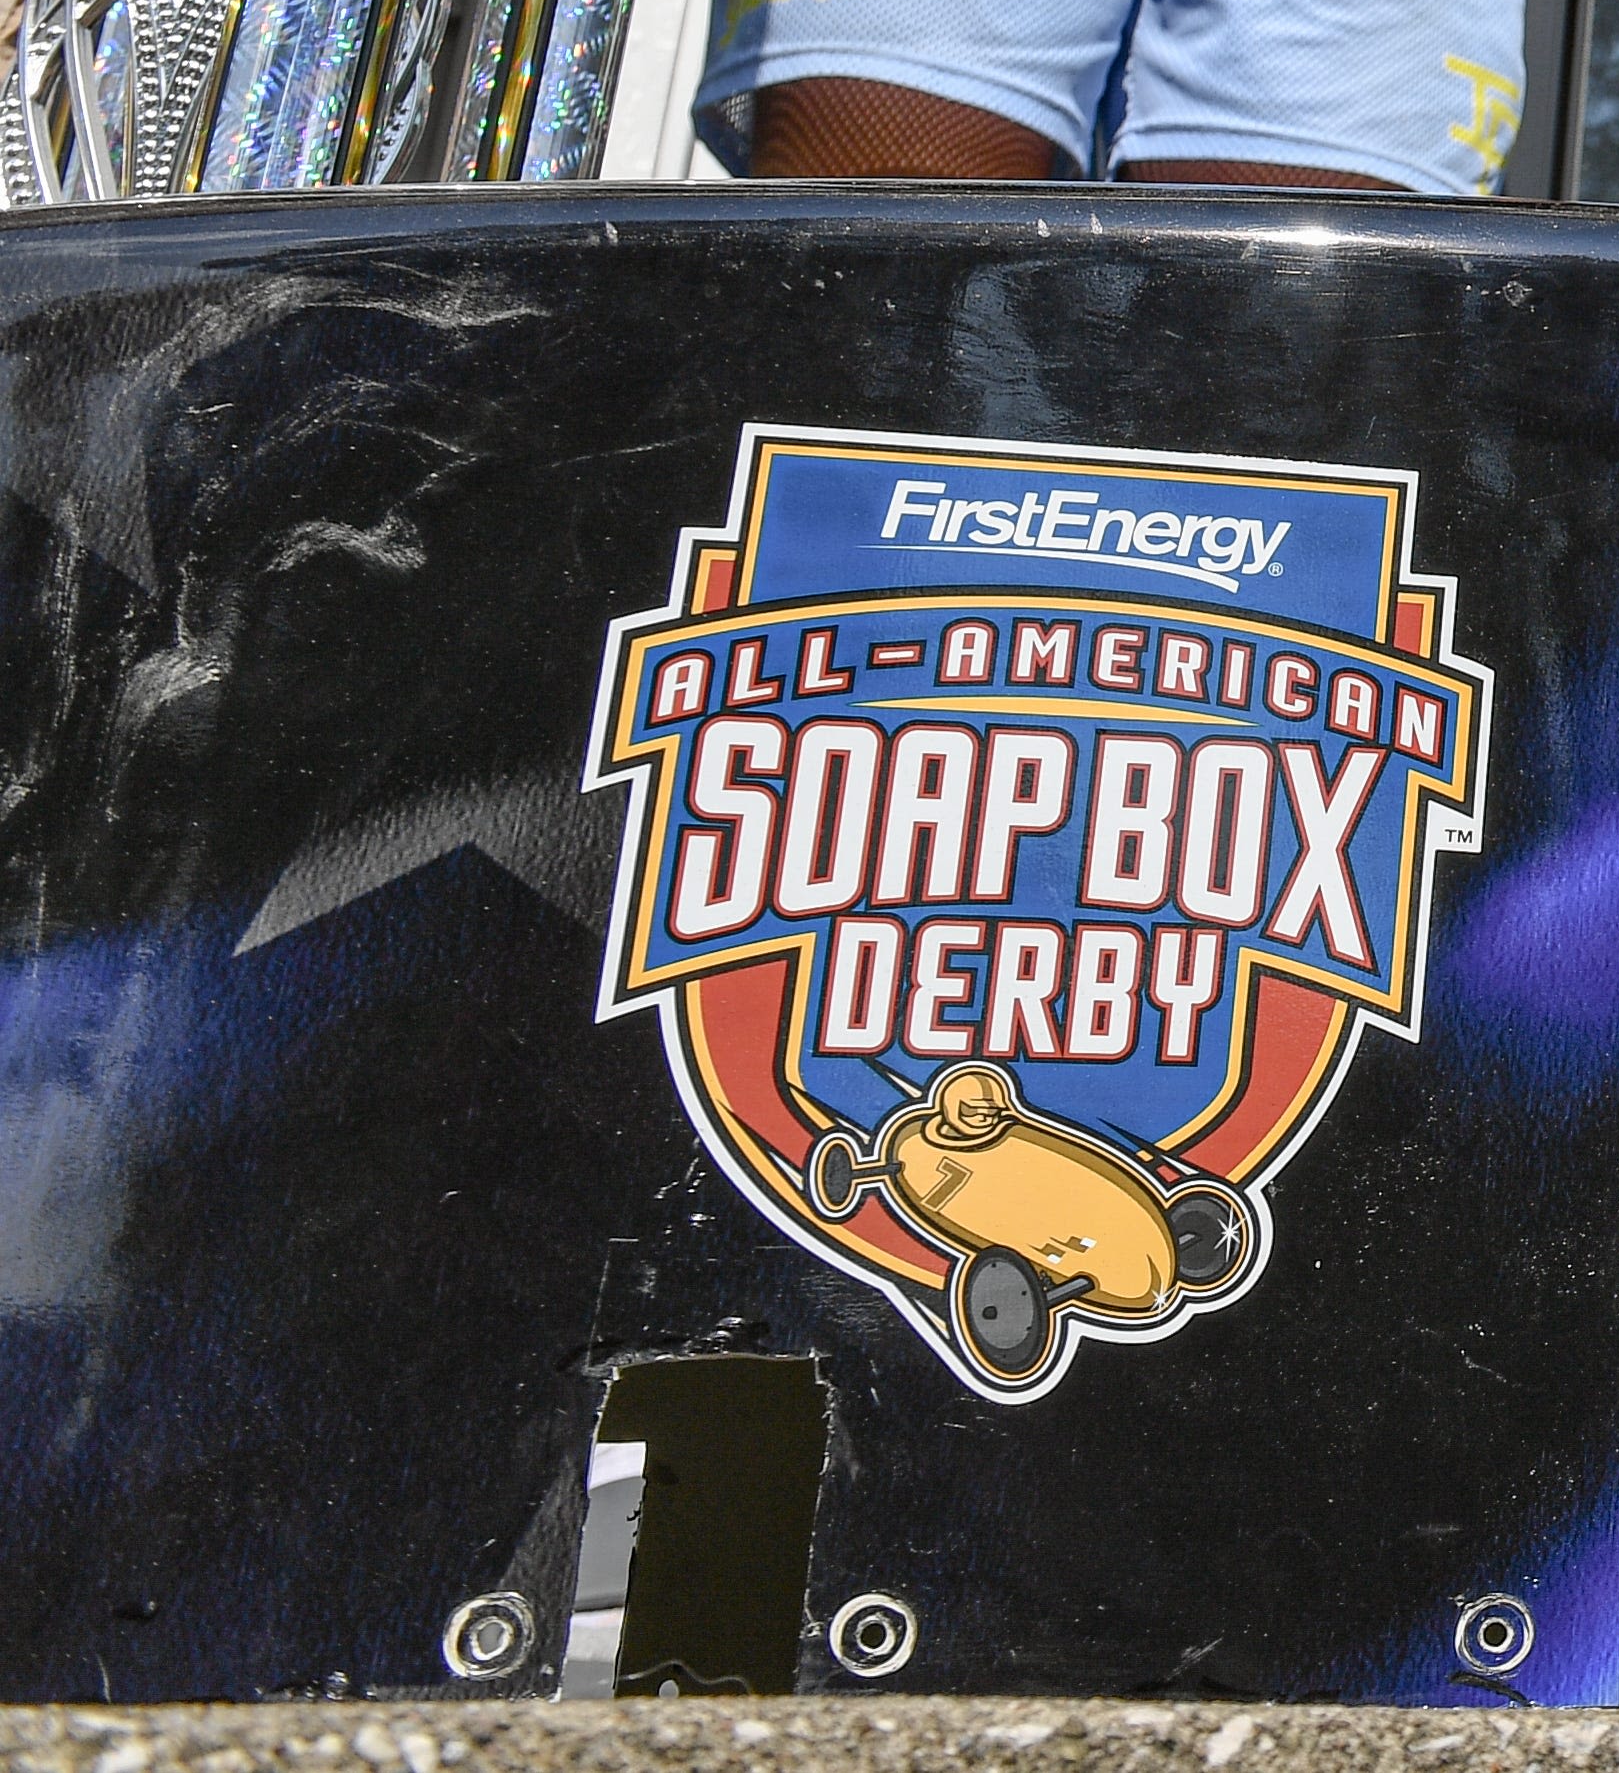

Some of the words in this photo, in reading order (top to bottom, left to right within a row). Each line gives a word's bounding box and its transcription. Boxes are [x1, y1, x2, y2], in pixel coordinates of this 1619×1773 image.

[880, 479, 1292, 575] FirstEnergy
[650, 620, 1446, 765] ALL-AMERICAN
[671, 717, 1075, 941] SOAP
[1080, 732, 1388, 970] BOX
[816, 915, 1226, 1064] DERBY
